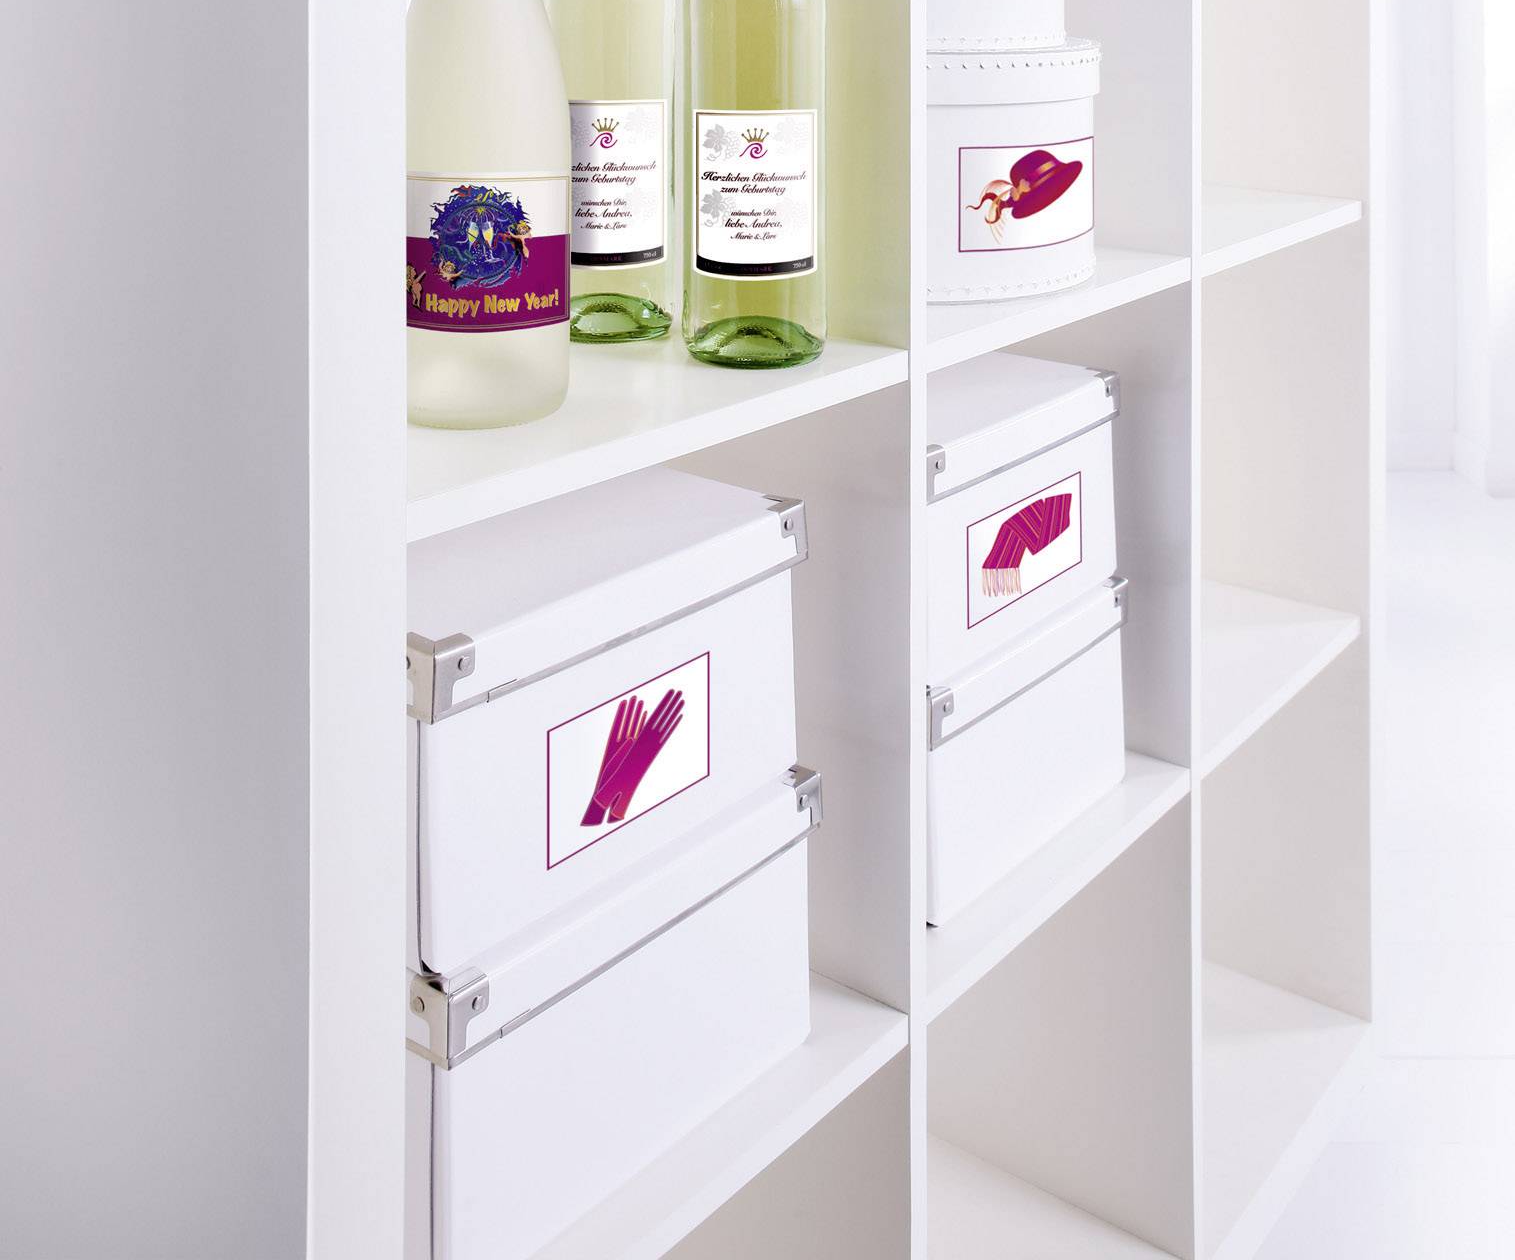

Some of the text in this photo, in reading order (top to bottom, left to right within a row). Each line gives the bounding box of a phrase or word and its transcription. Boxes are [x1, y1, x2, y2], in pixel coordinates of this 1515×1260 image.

[590, 173, 637, 186] Geburtstag
[701, 171, 750, 182] Herzlichen
[720, 184, 786, 196] zum Geburtstag
[425, 288, 559, 318] Happy New Year!
